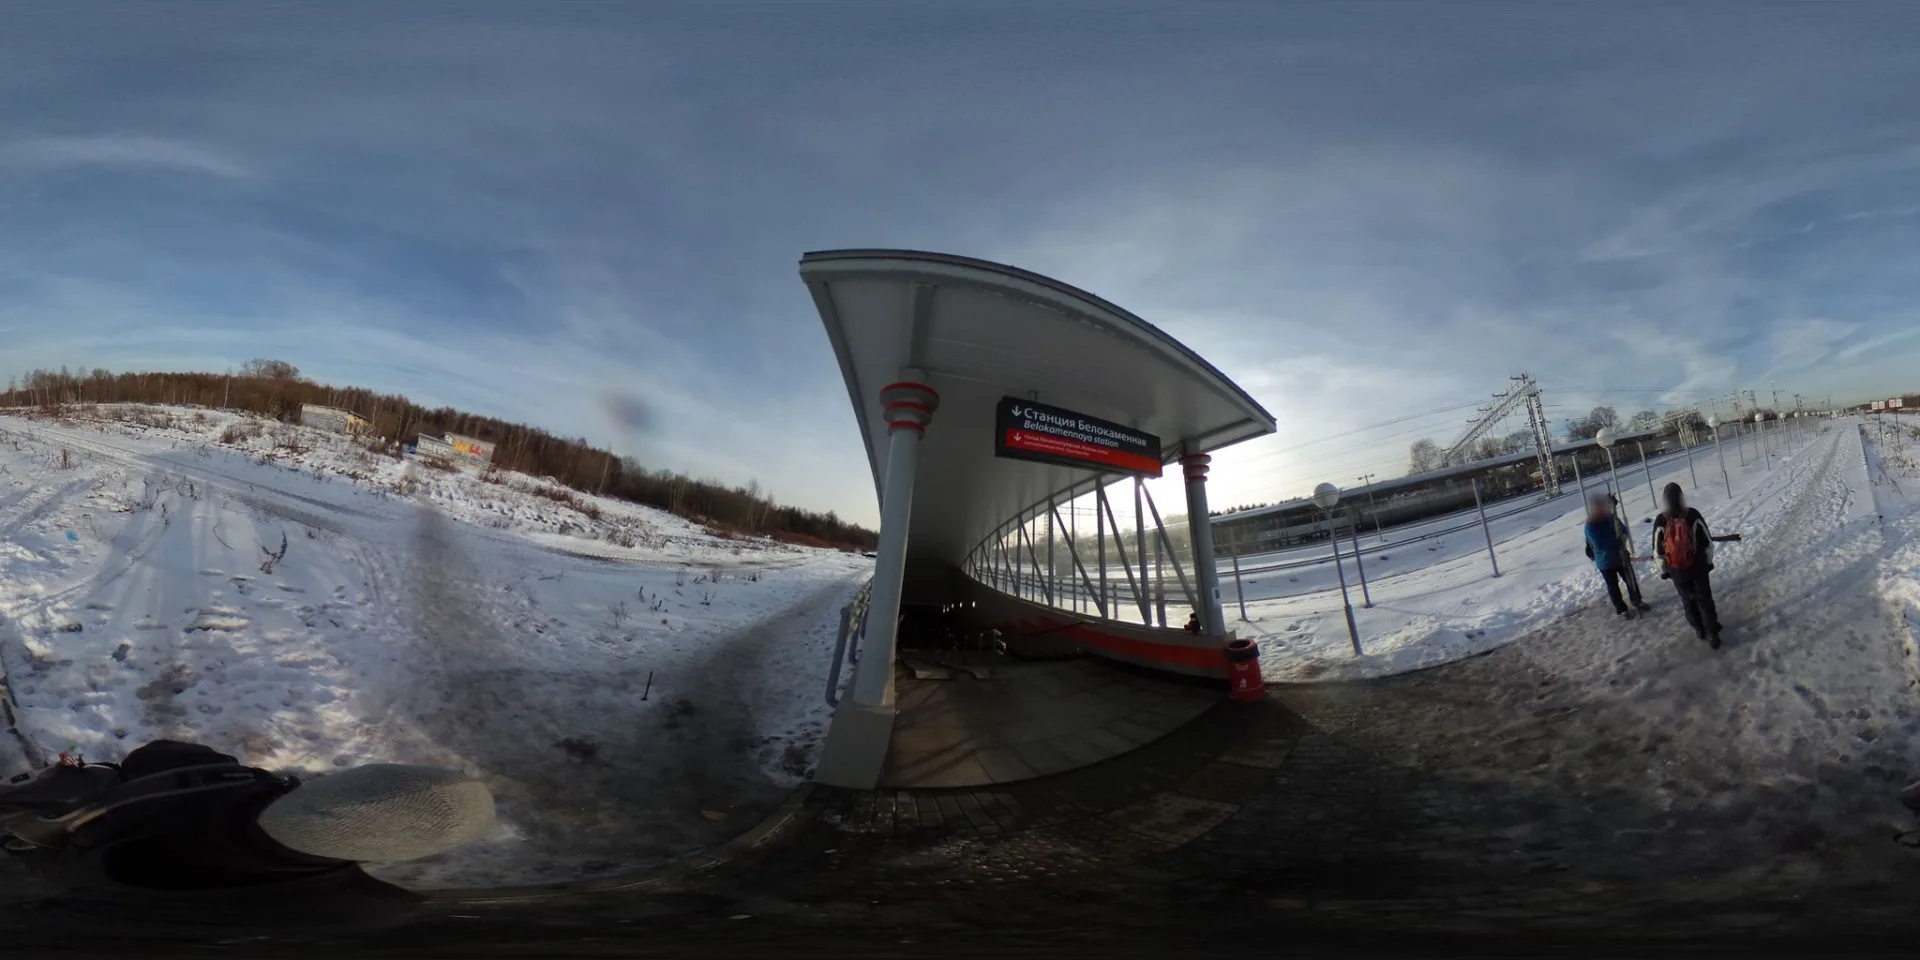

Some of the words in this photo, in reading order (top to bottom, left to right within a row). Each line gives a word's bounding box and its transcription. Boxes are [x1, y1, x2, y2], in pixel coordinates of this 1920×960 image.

[1023, 419, 1093, 443] Belokamennaya
[1094, 435, 1119, 448] station
[1024, 408, 1076, 429] Станция
[1078, 419, 1147, 447] Белокаменная
